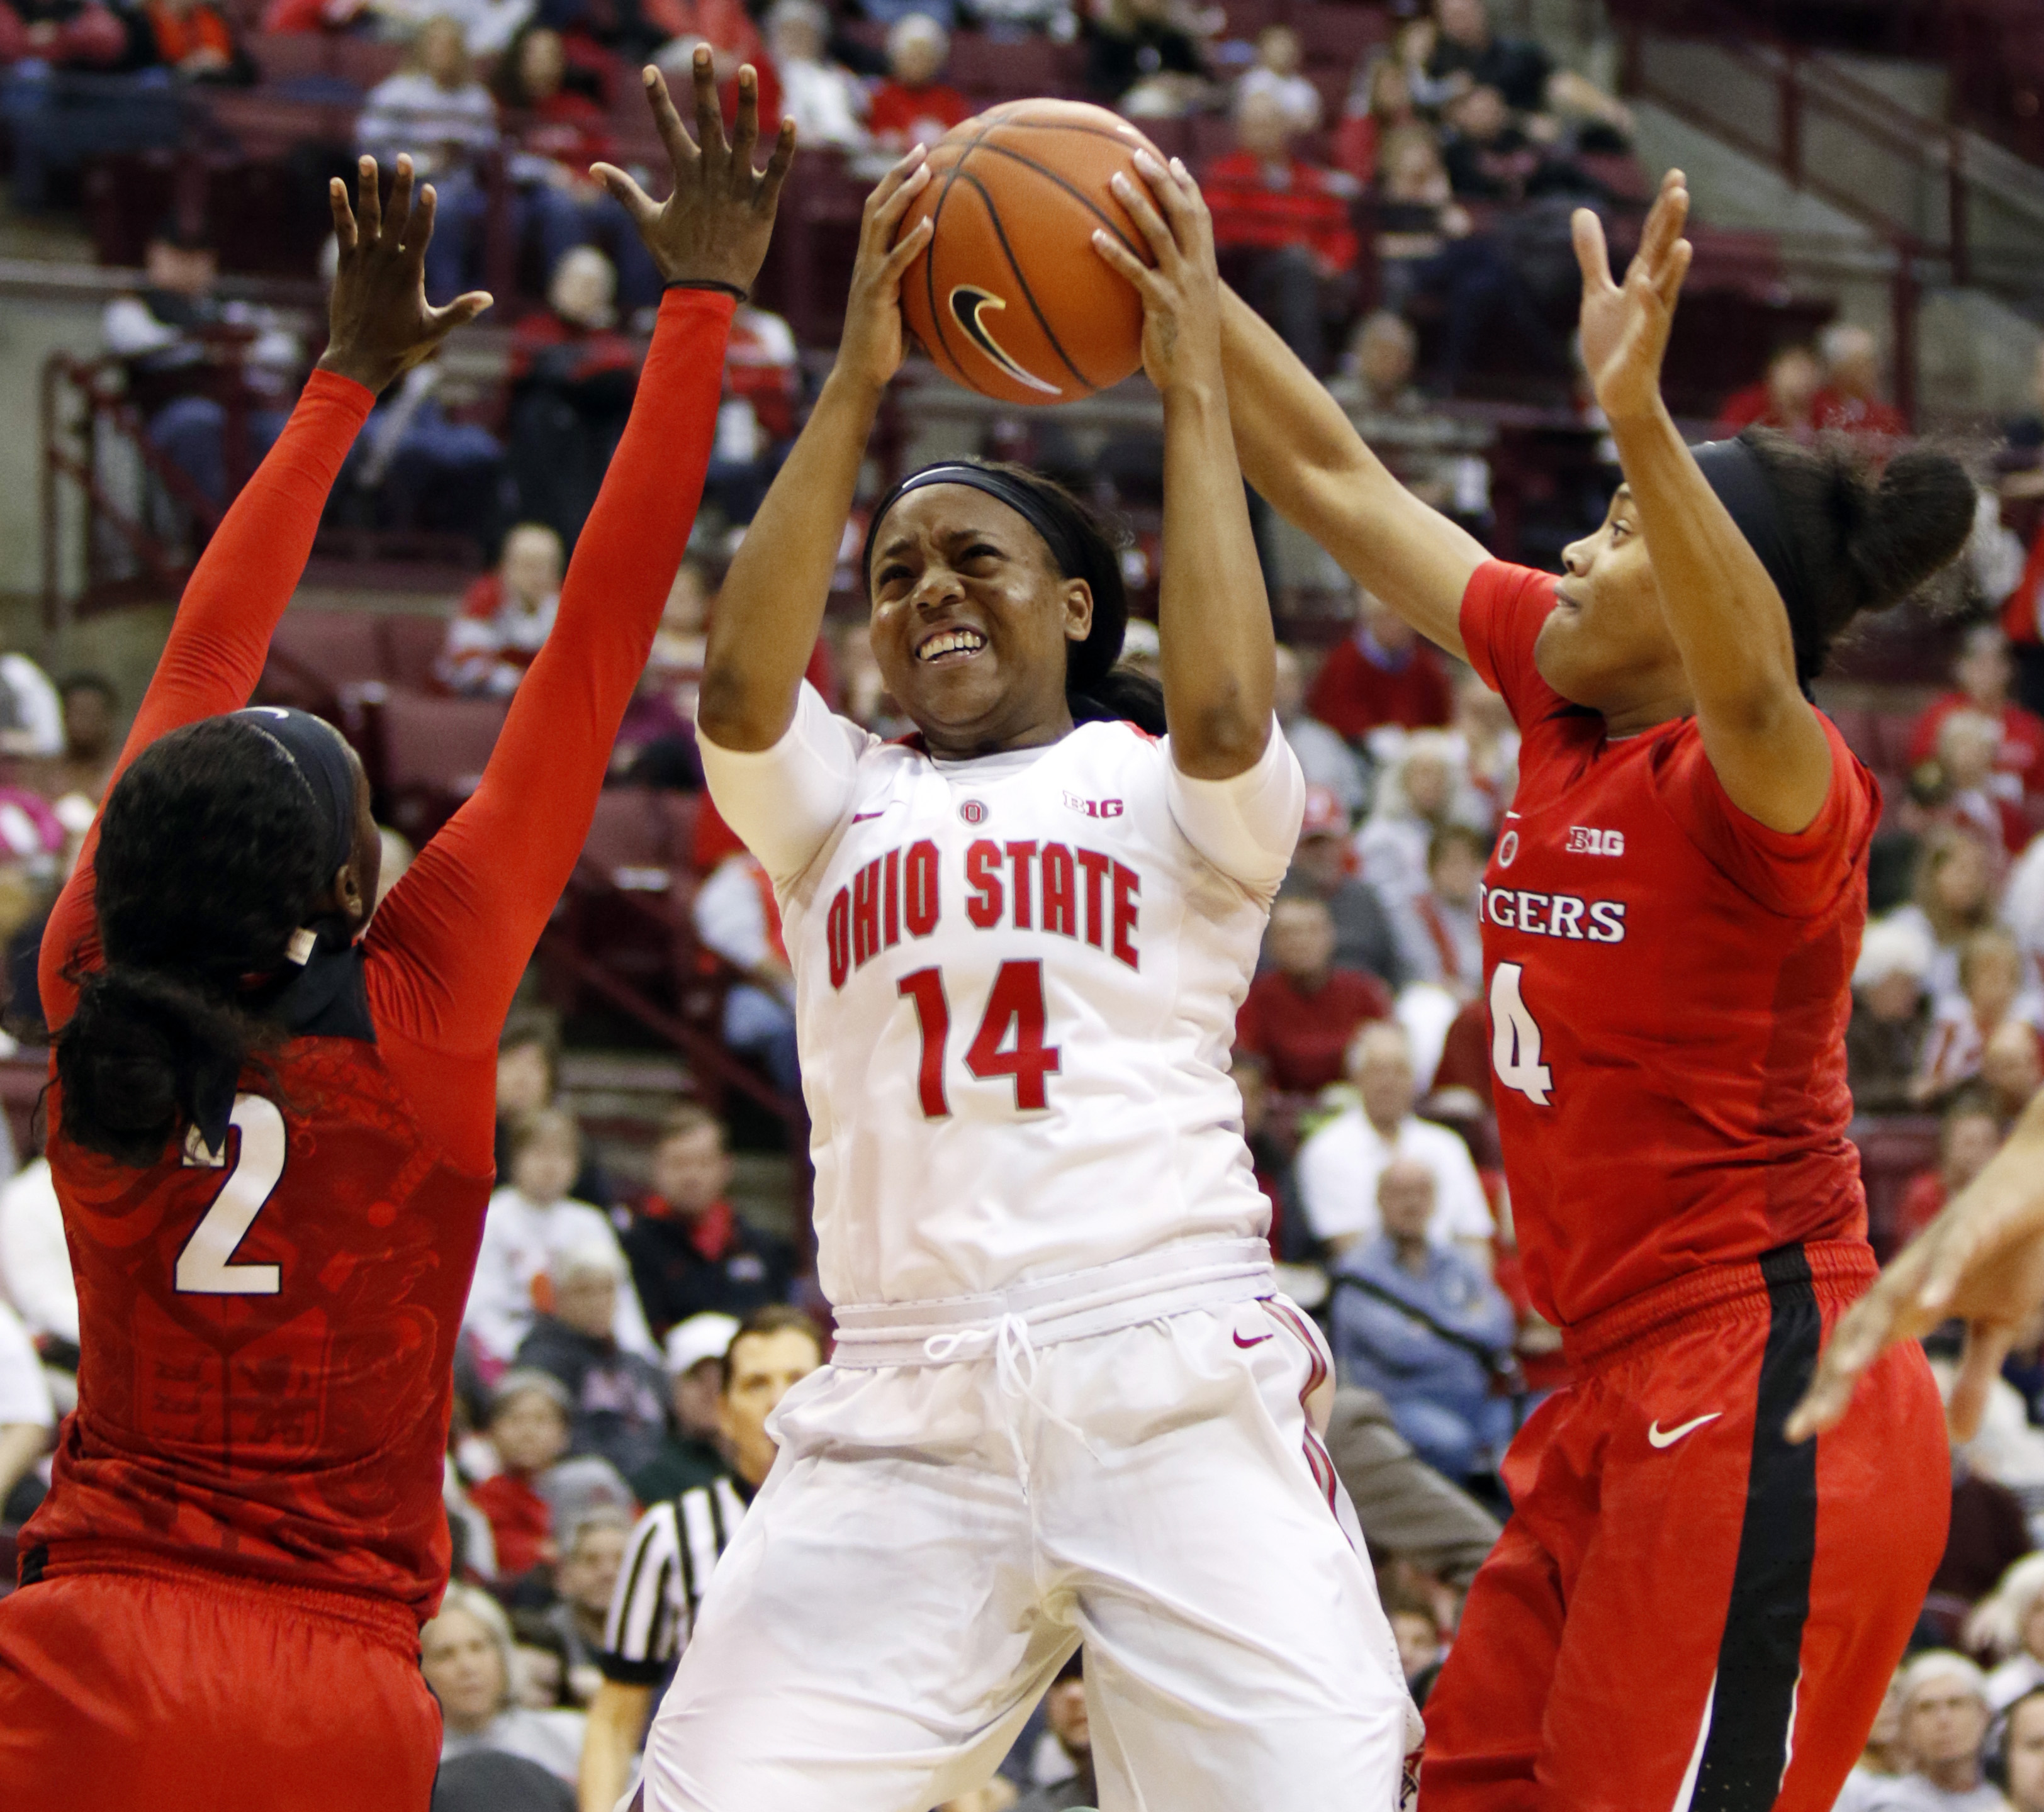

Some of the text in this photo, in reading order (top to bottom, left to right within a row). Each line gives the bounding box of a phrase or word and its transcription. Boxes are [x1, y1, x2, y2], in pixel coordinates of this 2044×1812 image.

[828, 839, 1142, 992] OHIO STATE
[897, 958, 1062, 1118] 14
[1490, 961, 1554, 1106] 4
[175, 1092, 286, 1294] 2
